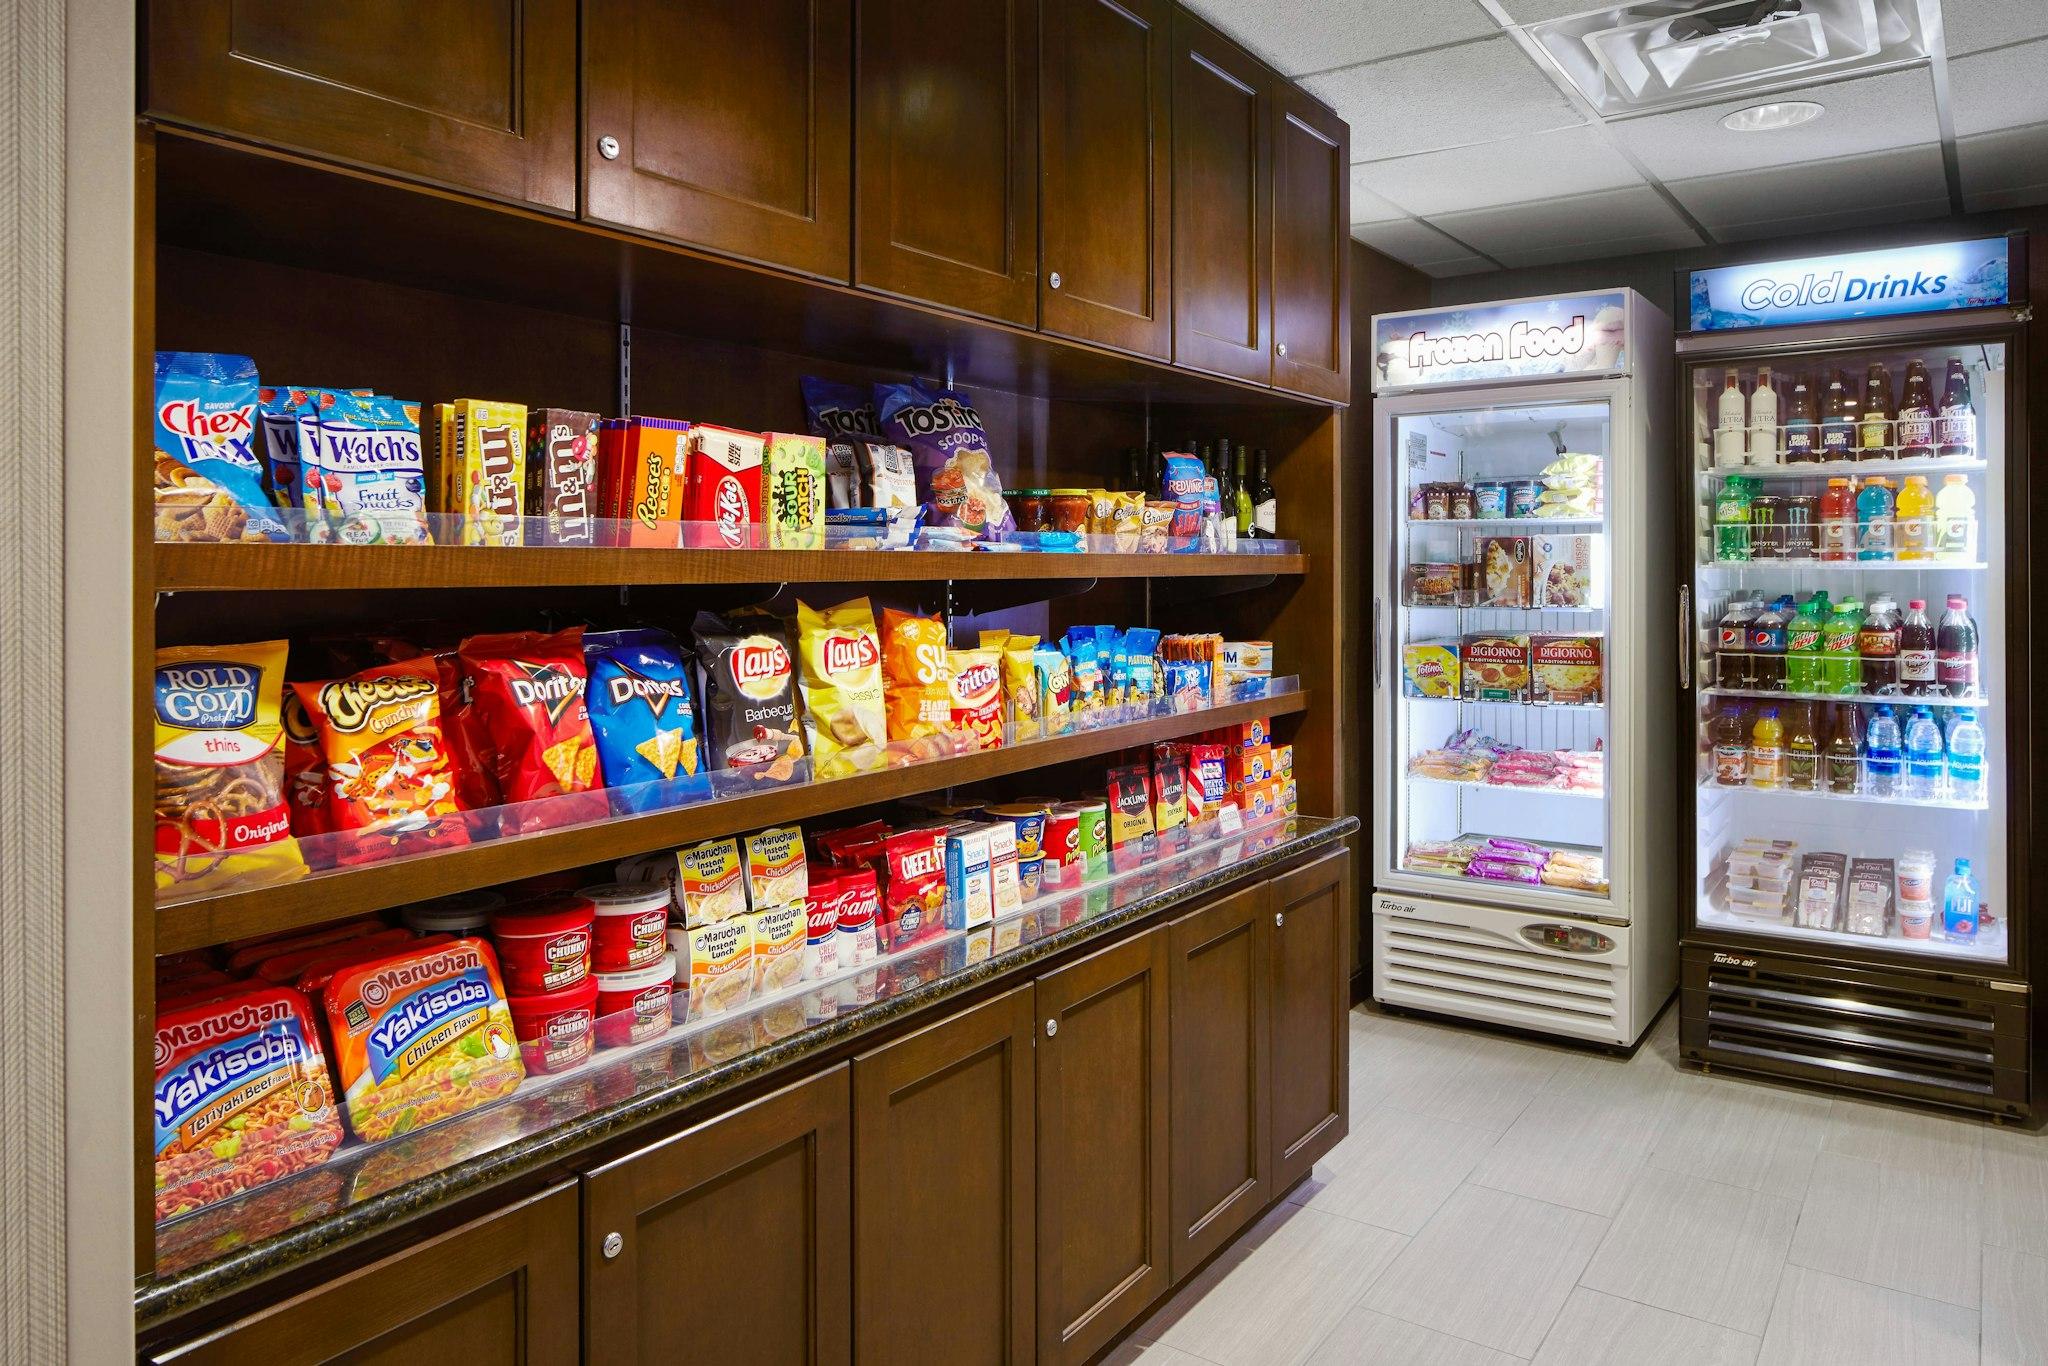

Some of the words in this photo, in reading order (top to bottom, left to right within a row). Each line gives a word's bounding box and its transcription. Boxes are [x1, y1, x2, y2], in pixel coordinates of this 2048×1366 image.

[1741, 271, 1843, 311] Cold
[1844, 272, 1947, 302] Drinks
[204, 401, 237, 411] SAVORY
[161, 399, 252, 436] Chex
[326, 434, 420, 464] Welch's
[512, 430, 520, 458] PEANUT
[728, 442, 736, 464] KING
[734, 444, 742, 467] SIZE
[359, 489, 400, 501] Fruit
[637, 452, 662, 530] Reese's
[797, 467, 812, 531] PATCH
[784, 471, 798, 529] SOUR
[1864, 636, 1891, 645] MUG
[163, 667, 250, 692] ROLD
[165, 688, 253, 722] GOLD
[322, 676, 434, 731] Cheetos
[745, 702, 794, 722] Barbecue
[369, 701, 422, 734] Crunchy
[204, 738, 241, 753] thins
[234, 813, 289, 843] Original
[759, 831, 797, 846] Maruchan
[693, 843, 733, 860] Maruchan
[764, 843, 790, 855] Instant
[768, 852, 789, 862] Lunch
[697, 856, 725, 870] Instant
[701, 865, 724, 877] Lunch
[765, 864, 793, 876] Chicken
[699, 879, 728, 892] Chicken
[1380, 900, 1402, 911] Turbo
[1403, 905, 1416, 913] air
[765, 908, 801, 924] Maruchan
[704, 925, 746, 942] Maruchan
[768, 921, 793, 933] Instant
[772, 929, 791, 940] Lunch
[548, 940, 586, 960] CHUNKY
[708, 938, 737, 952] Instant
[712, 947, 735, 959] Lunch
[768, 941, 792, 954] Chicken
[629, 948, 653, 960] BEEF
[1713, 953, 1740, 965] Turbo
[378, 952, 479, 989] Maruchan
[708, 960, 738, 974] Chicken
[545, 970, 572, 984] BEEF
[162, 1002, 291, 1048] Maruchan
[375, 983, 486, 1052] Yakisoba
[549, 1018, 588, 1038] CHUNKY
[407, 1026, 451, 1066] Chicken
[454, 1012, 480, 1034] Flavor
[546, 1048, 573, 1062] BEEF
[156, 1034, 298, 1121] Yakisoba
[189, 1095, 245, 1137] Teriyaki
[247, 1077, 273, 1100] Beef
